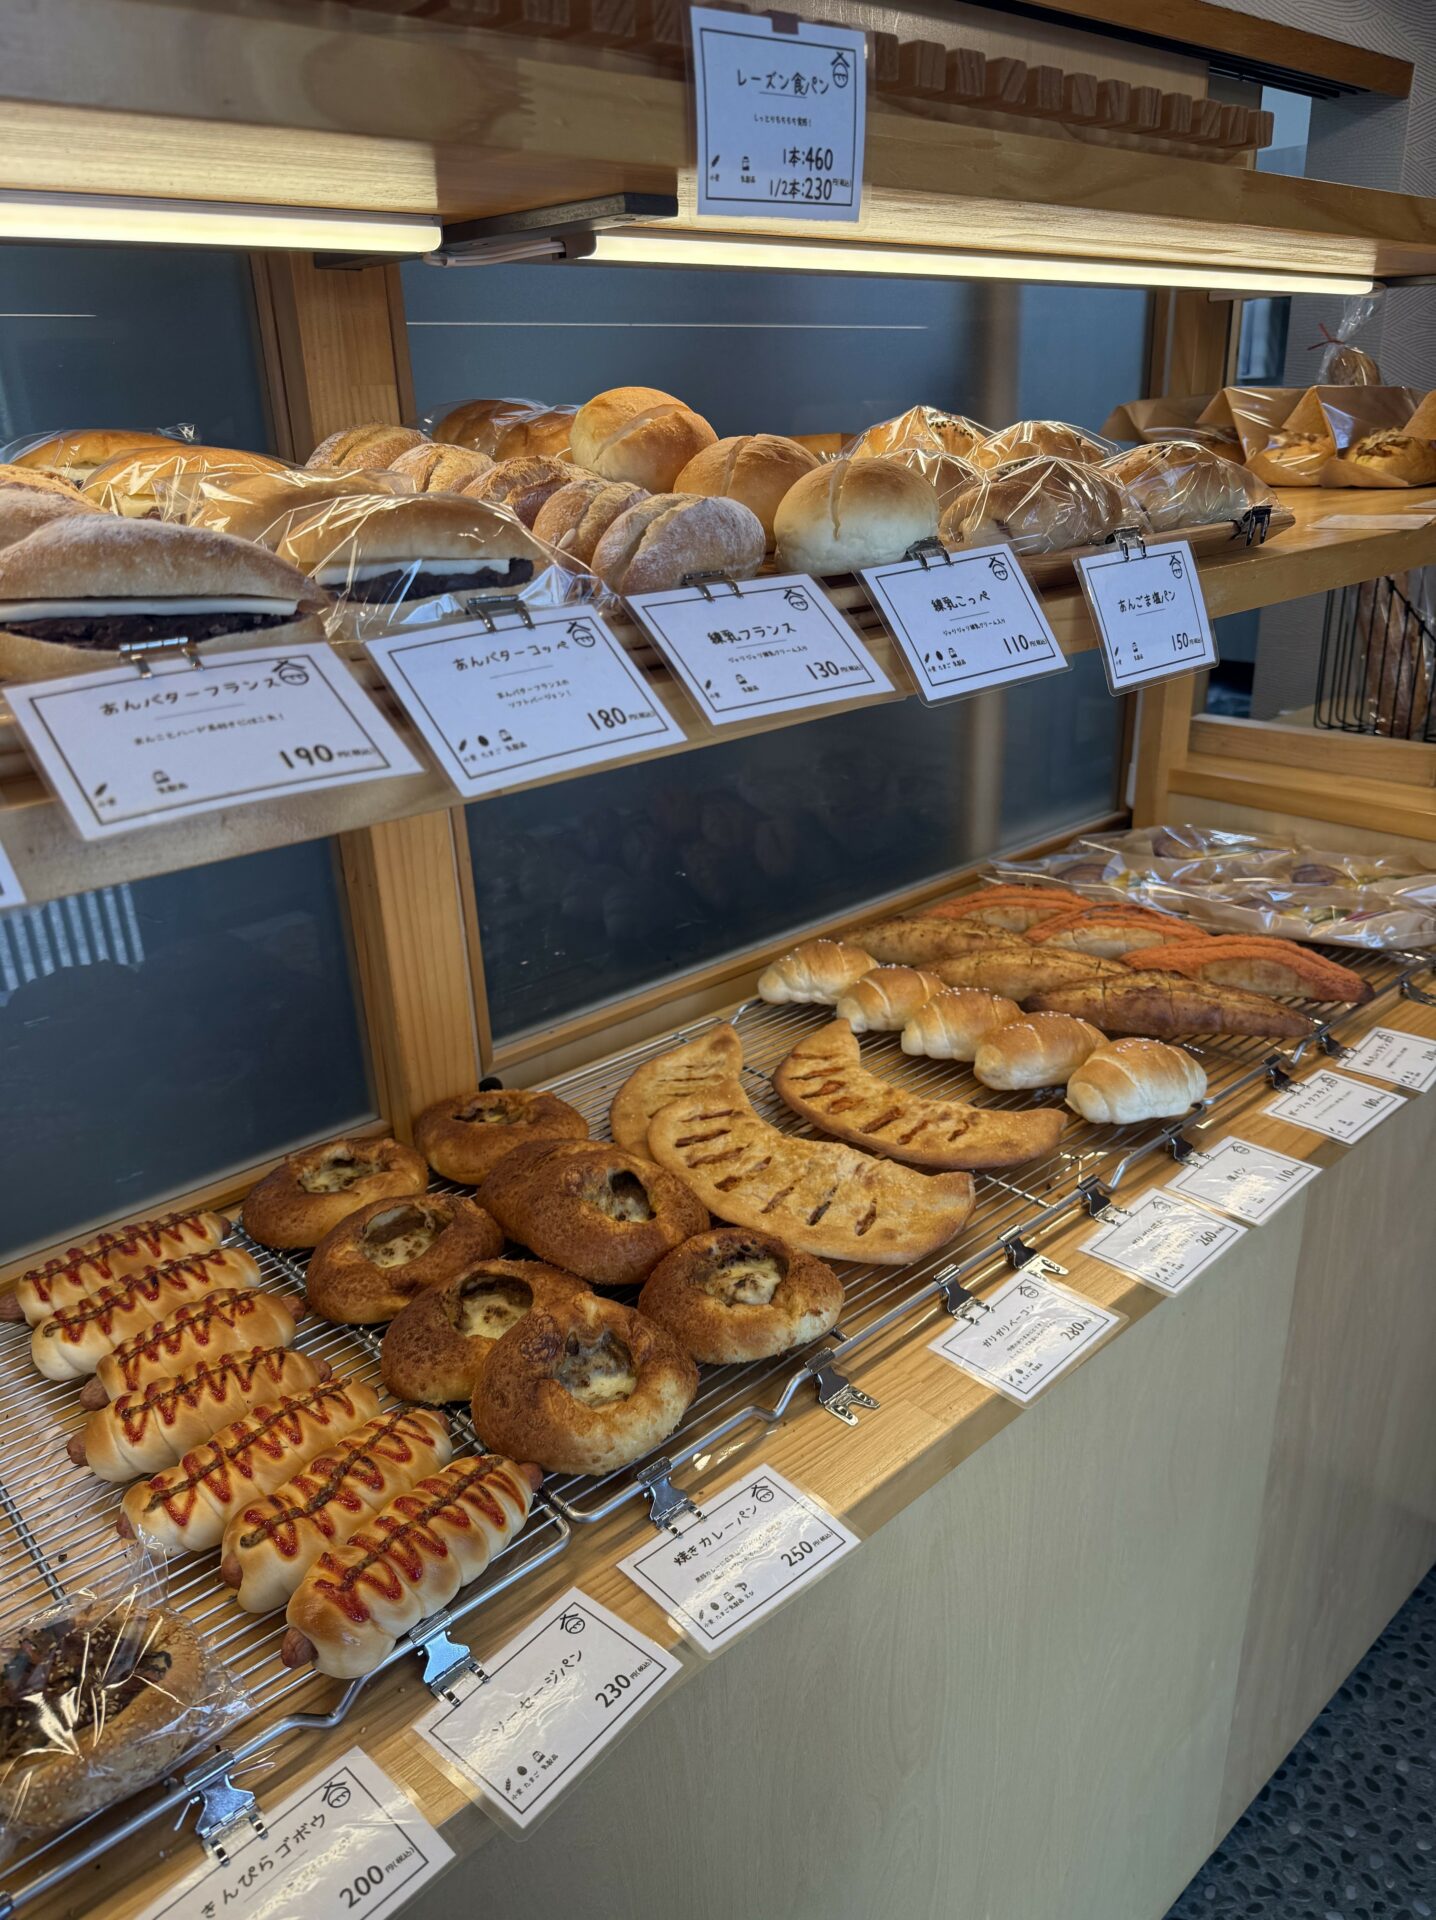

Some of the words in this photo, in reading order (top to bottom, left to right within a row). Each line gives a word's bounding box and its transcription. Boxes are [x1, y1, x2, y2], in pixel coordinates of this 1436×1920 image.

[736, 64, 829, 98] レーズン食パン
[929, 588, 992, 613] 練乳こっぺ
[1117, 588, 1176, 612] あんごま塩パン
[705, 620, 798, 646] 練乳フランス
[1001, 633, 1031, 654] 110
[1170, 631, 1190, 651] 150
[803, 659, 842, 680] 130
[96, 675, 283, 716] あんバターフランス
[585, 705, 631, 731] 180
[276, 741, 338, 770] 190
[1194, 1229, 1219, 1246] 260
[1058, 1320, 1087, 1341] 280
[669, 1501, 761, 1567] 焼きカレーパン
[778, 1538, 816, 1567] 250
[488, 1647, 587, 1737] ソーセージパン
[592, 1671, 633, 1709] 230
[197, 1808, 330, 1920] きんぴらゴボウ
[336, 1860, 387, 1911] 200
